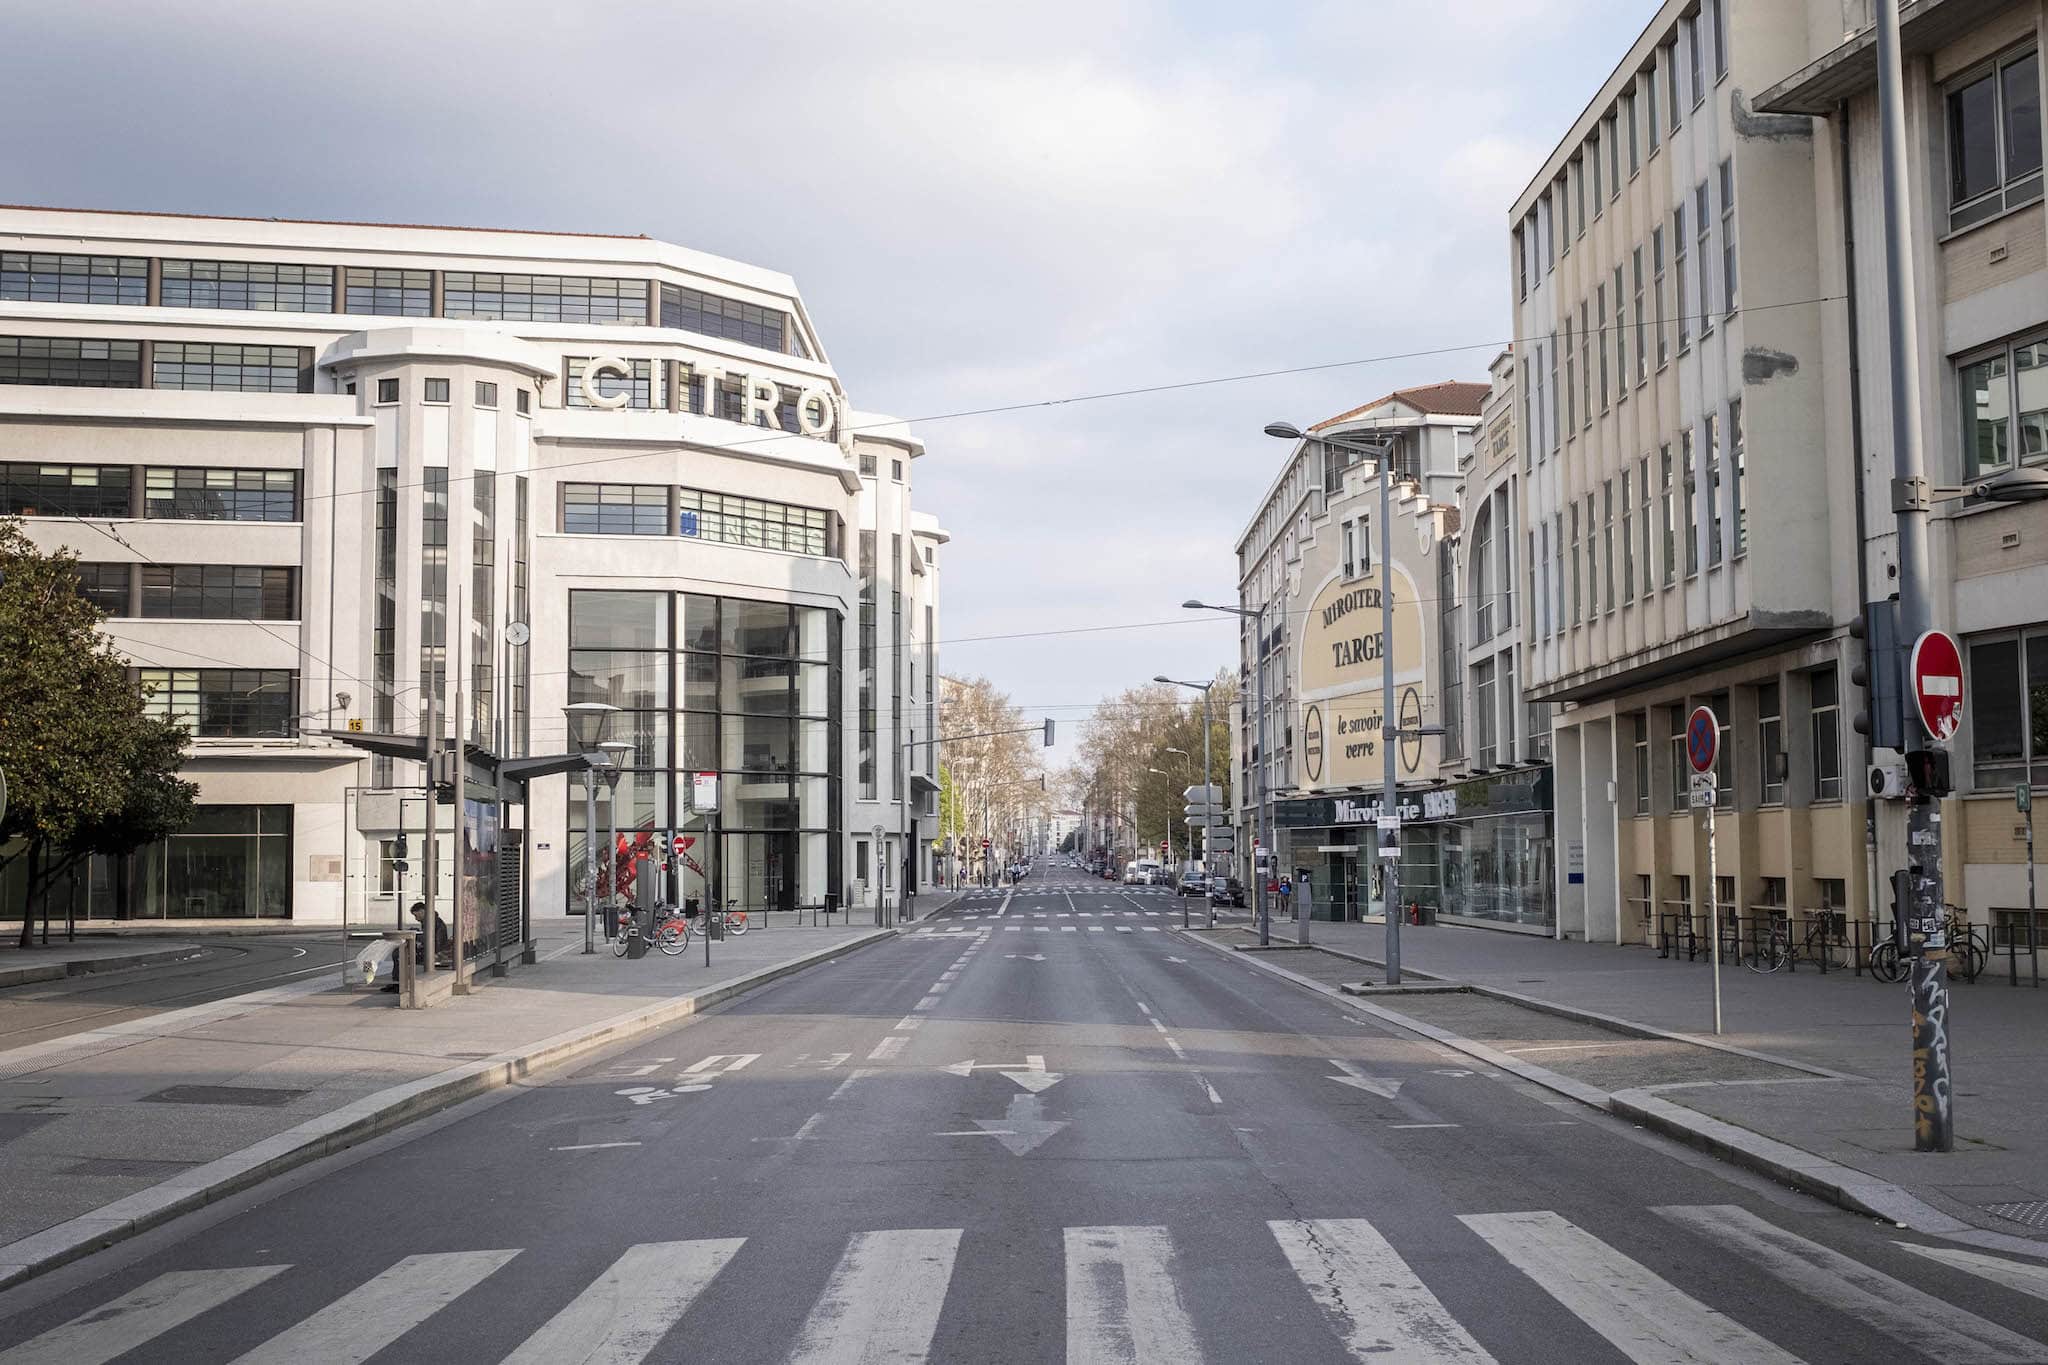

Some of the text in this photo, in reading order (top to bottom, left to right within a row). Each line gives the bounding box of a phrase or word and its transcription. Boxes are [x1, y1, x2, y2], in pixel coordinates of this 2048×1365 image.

[1322, 588, 1395, 629] MIROITER
[1332, 632, 1384, 667] TARGE
[350, 722, 361, 731] 15
[1337, 714, 1347, 735] le
[1349, 709, 1383, 734] savoir
[1345, 742, 1374, 759] verre
[1335, 798, 1420, 823] Miroitrie
